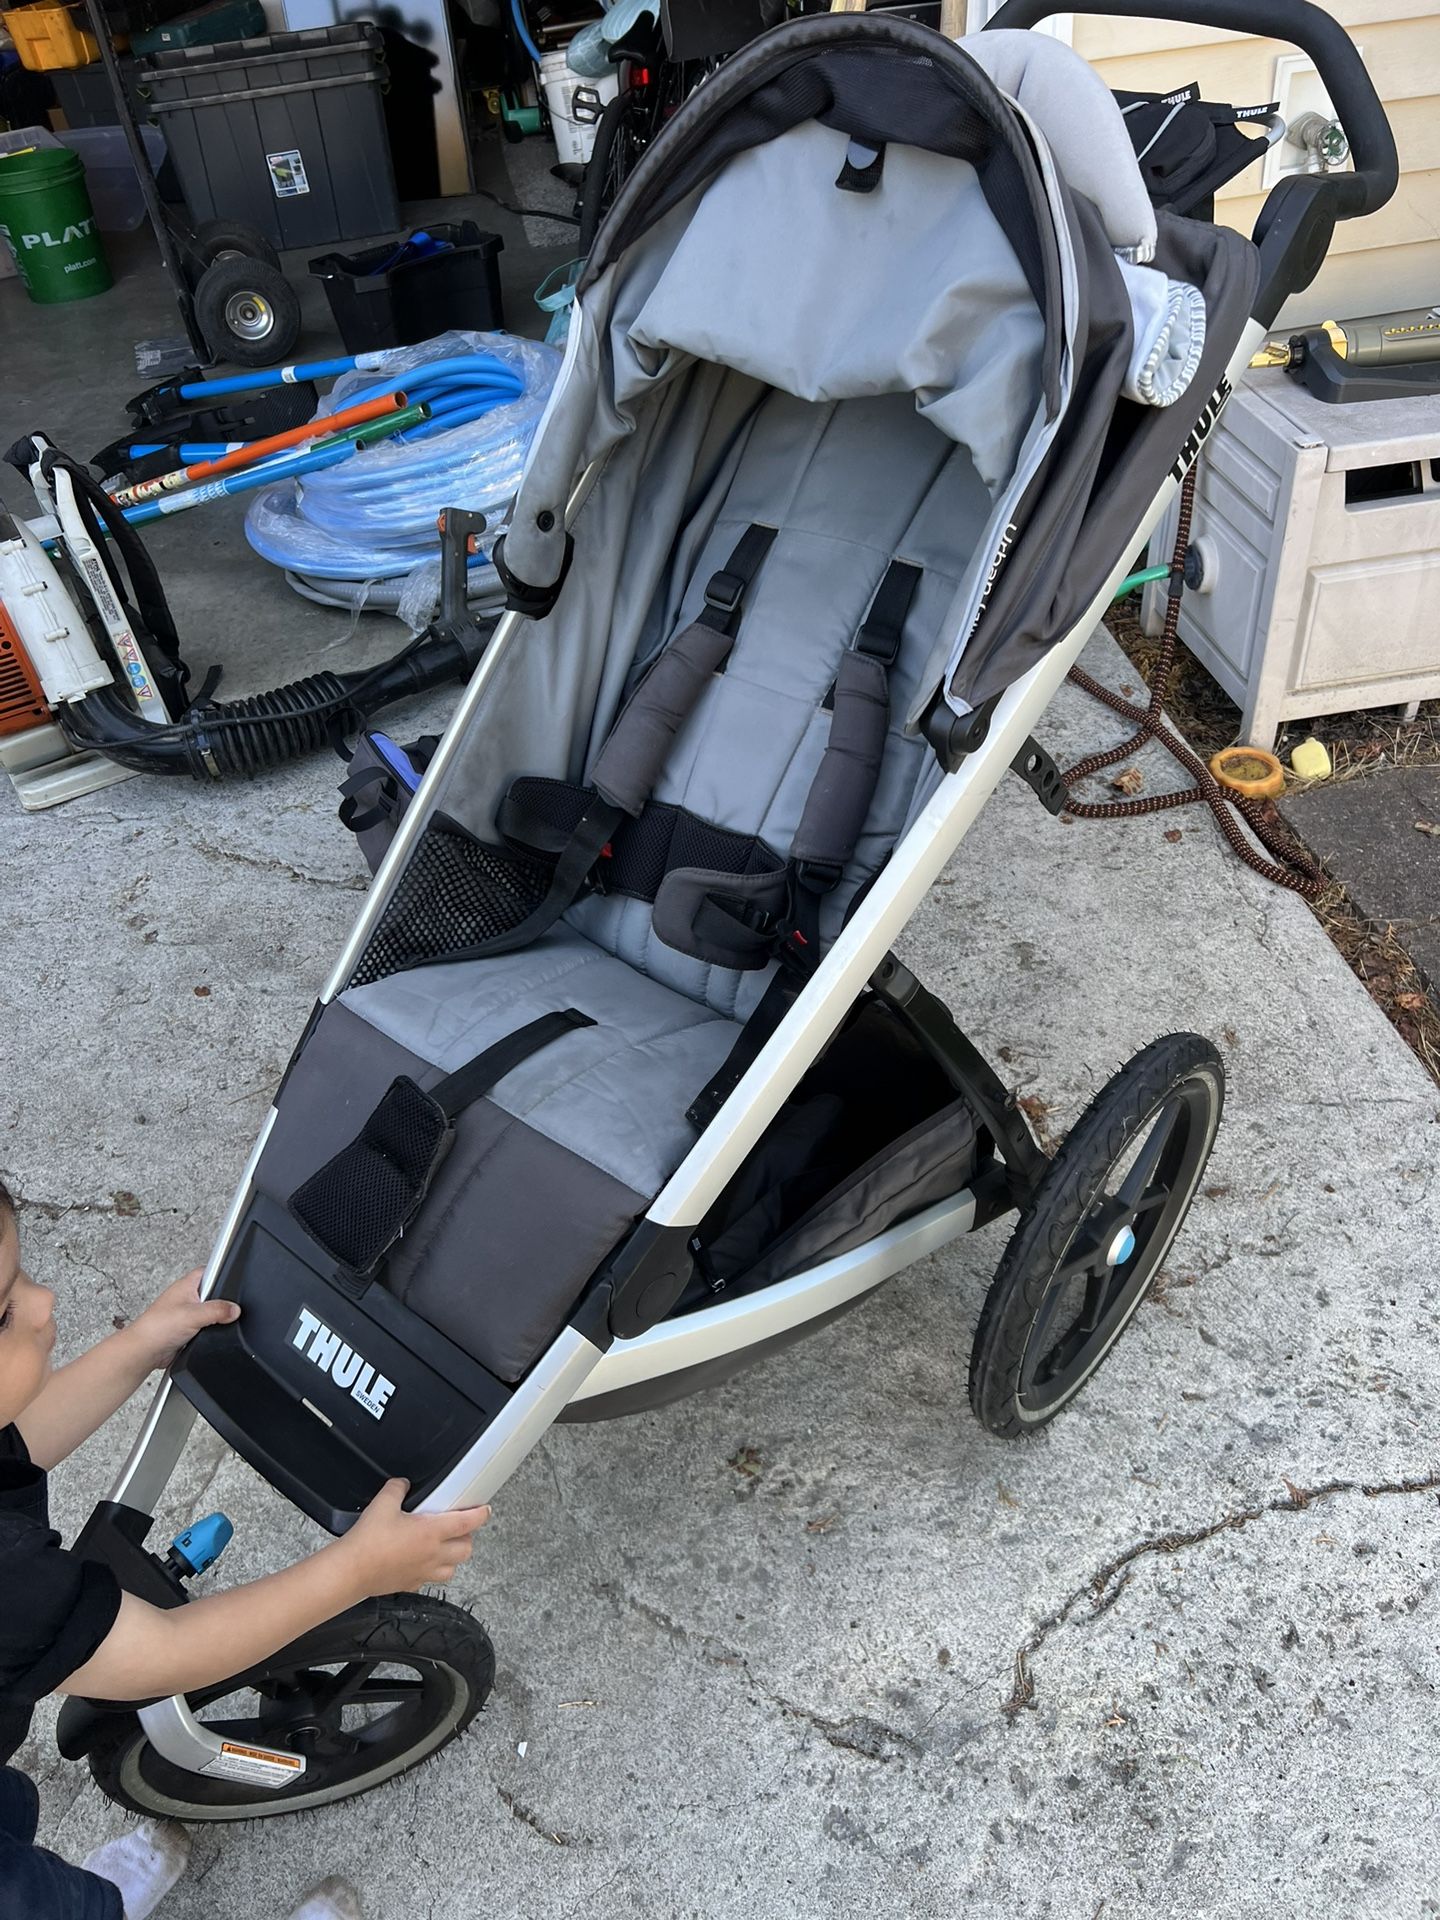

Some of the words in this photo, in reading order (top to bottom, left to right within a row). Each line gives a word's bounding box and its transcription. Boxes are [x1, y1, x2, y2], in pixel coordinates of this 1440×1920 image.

[1236, 106, 1268, 119] THULE
[64, 257, 97, 274] platt.com
[1168, 374, 1232, 484] THULE
[983, 523, 1017, 595] Urban
[292, 1307, 396, 1420] THULE
[355, 1390, 381, 1413] SWEDEN
